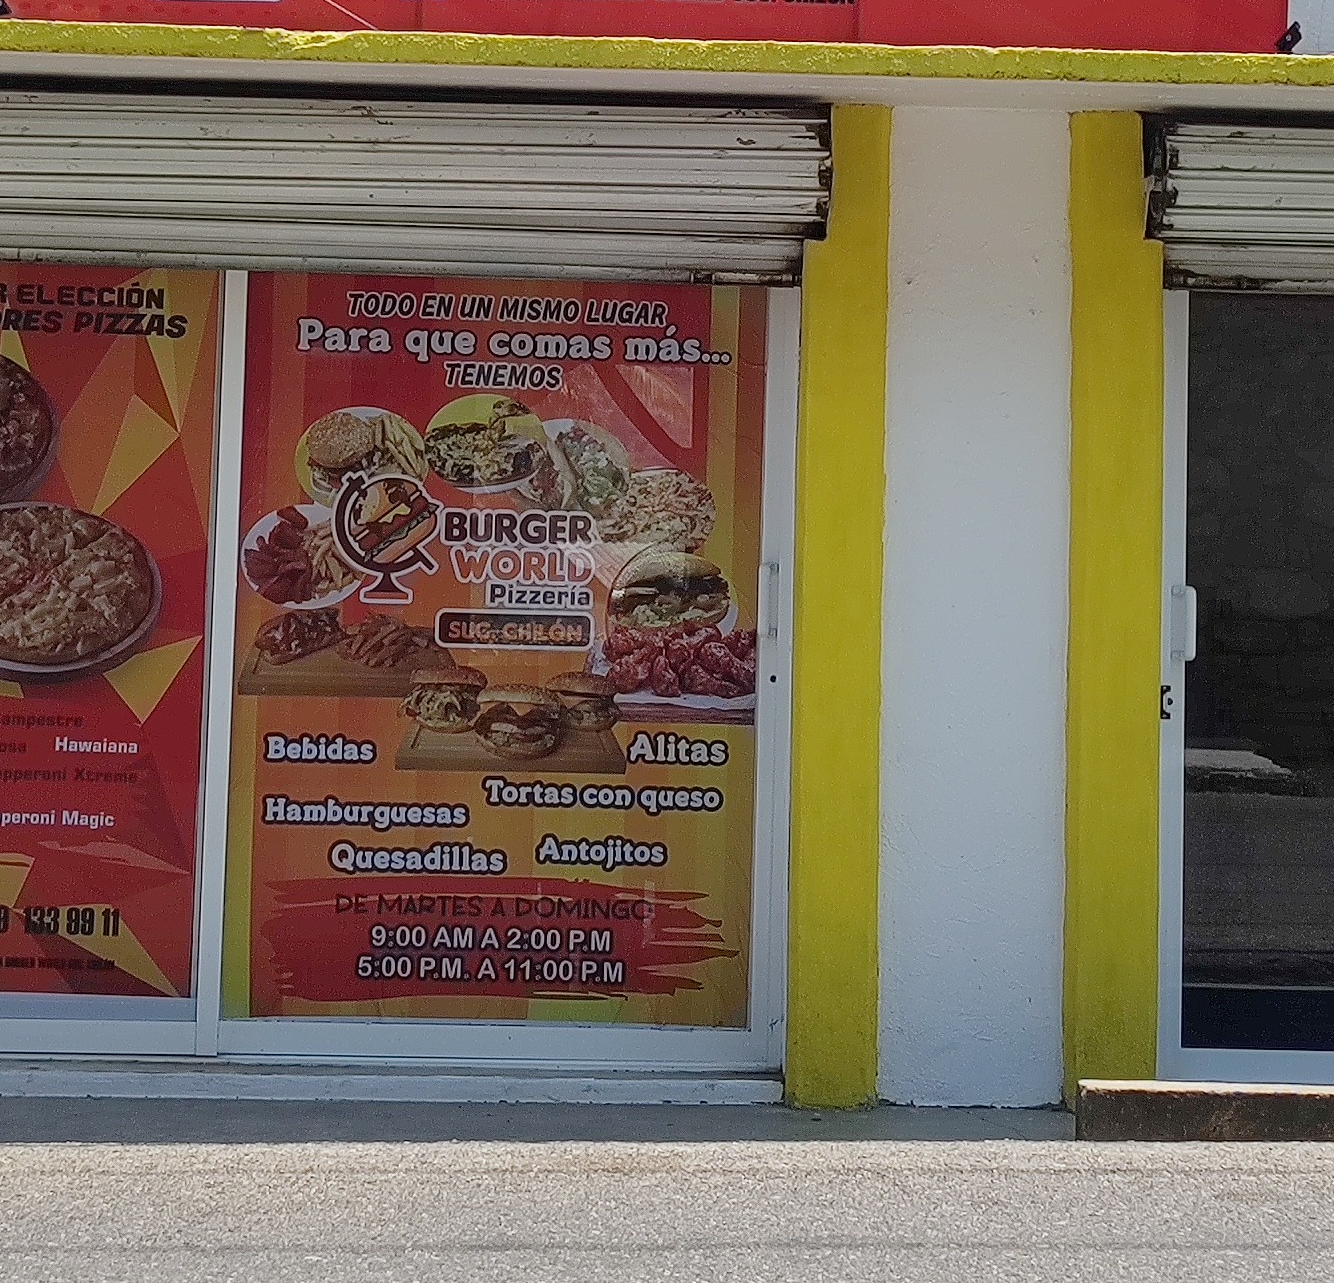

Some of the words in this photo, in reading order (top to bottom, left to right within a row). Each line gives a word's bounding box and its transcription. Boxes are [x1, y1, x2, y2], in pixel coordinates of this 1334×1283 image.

[16, 281, 165, 310] ELECCIÓN
[348, 292, 415, 317] TODO
[421, 294, 454, 318] EN
[461, 295, 494, 320] UN
[499, 297, 579, 323] MISMO
[587, 300, 667, 327] LUGAR
[72, 311, 189, 339] PIZZAS
[297, 317, 392, 352] Para
[405, 329, 476, 361] que
[489, 330, 610, 360] comas
[624, 325, 731, 365] más...
[444, 361, 563, 390] TENEMOS
[444, 511, 592, 545] BURGER
[454, 548, 592, 583] WORLD
[489, 583, 591, 606] Pizzería
[54, 736, 139, 754] Hawaiana
[265, 736, 375, 762] Bebidas
[629, 734, 728, 764] Alitas
[485, 779, 574, 806] Tortas
[583, 787, 631, 806] con
[639, 789, 721, 814] queso
[61, 809, 115, 830] Magic
[264, 798, 467, 828] Hamburguesas
[331, 843, 505, 873] Quesadillas
[538, 836, 665, 869] Antojitos
[23, 905, 60, 936] 133
[101, 908, 120, 937] 11
[335, 893, 369, 915] DE
[377, 894, 483, 918] MARTES
[491, 896, 507, 917] A
[515, 896, 655, 920] DOMINGO
[371, 925, 427, 948] 9:00
[433, 926, 474, 949] AM
[480, 927, 500, 949] A
[506, 928, 561, 951] 2:00
[568, 929, 611, 953] P.M
[357, 955, 412, 978] 5:00
[477, 960, 496, 980] A
[504, 959, 574, 982] 11:00
[581, 961, 623, 983] P.M
